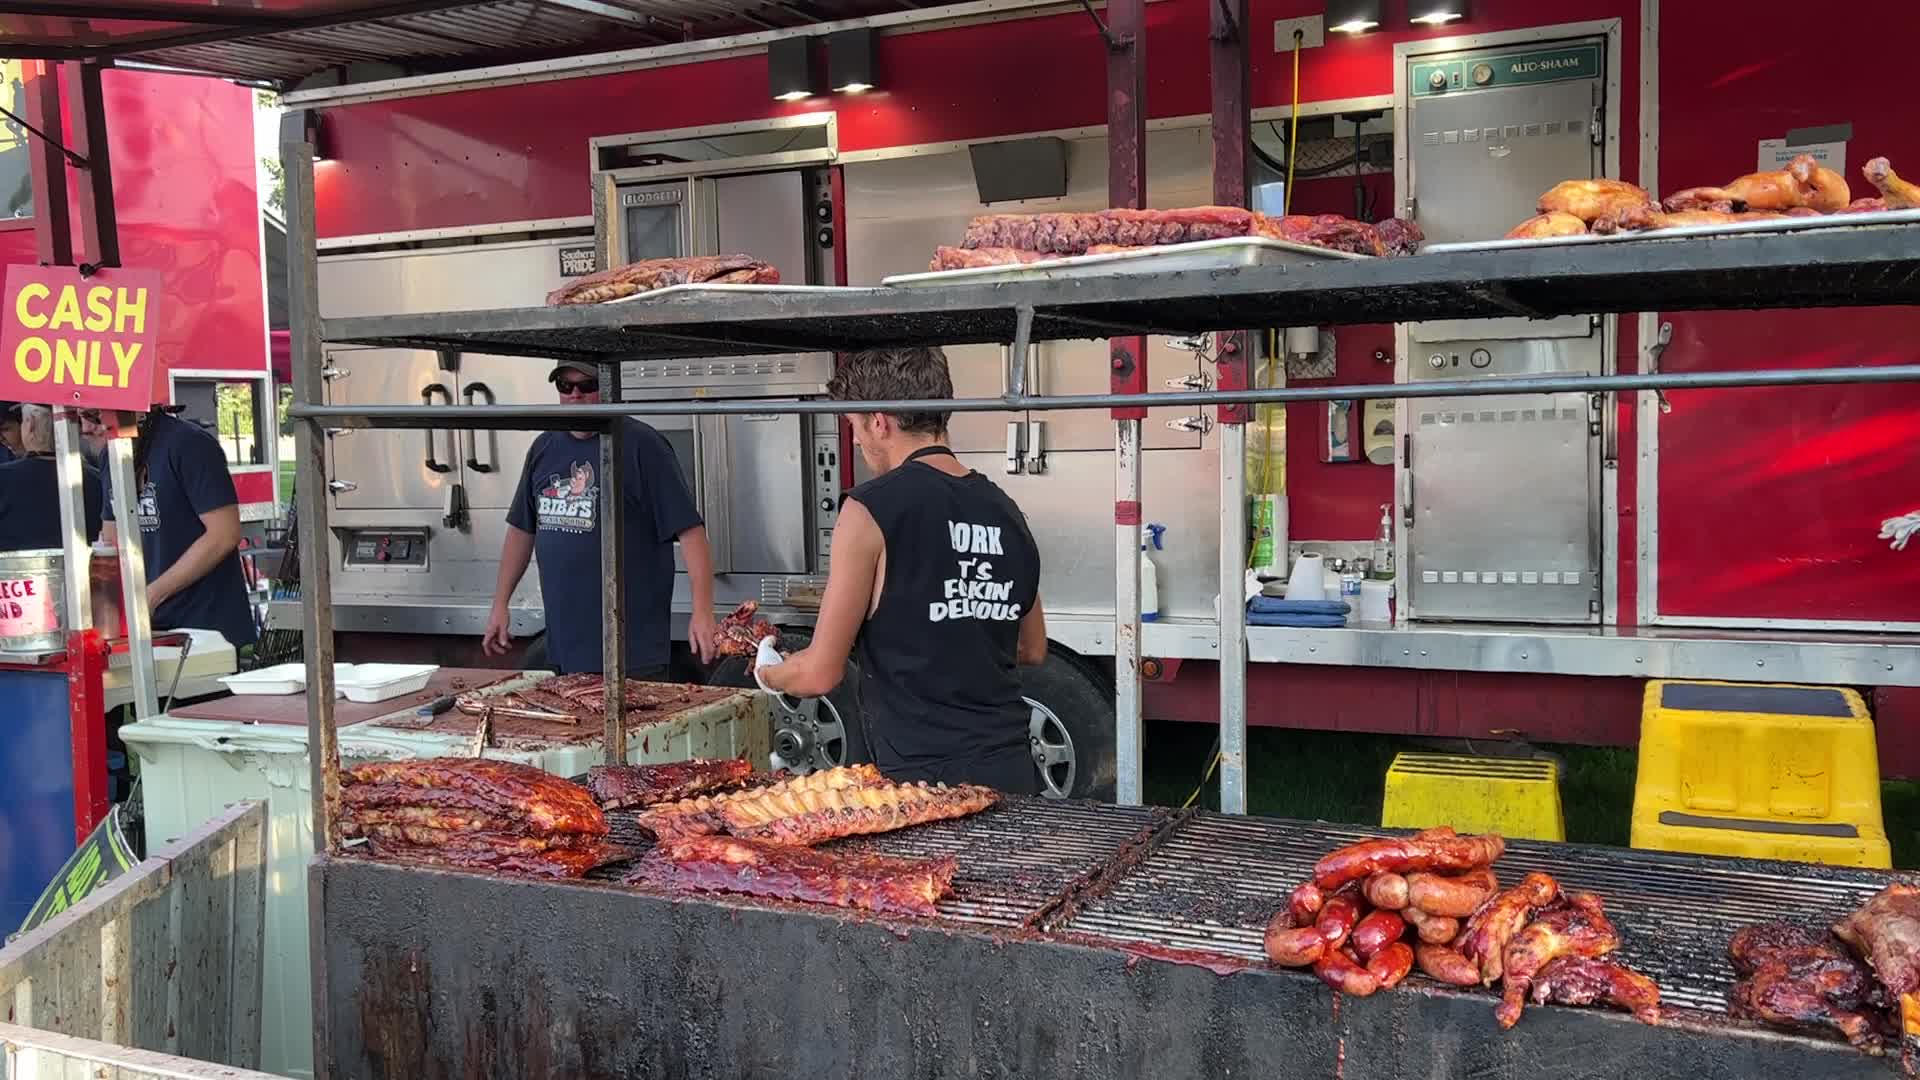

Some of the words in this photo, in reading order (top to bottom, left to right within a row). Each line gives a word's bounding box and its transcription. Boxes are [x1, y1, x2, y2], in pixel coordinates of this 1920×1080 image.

[1510, 57, 1579, 74] ALTO-SHAAM
[626, 190, 677, 204] BLODGETT
[560, 249, 595, 260] Southern
[562, 259, 595, 274] PRIDE
[15, 282, 148, 334] CASH
[14, 336, 143, 389] ONLY
[538, 497, 593, 518] BIBB'S
[957, 557, 993, 581] T'S
[0, 580, 36, 599] EGE
[0, 601, 23, 619] ND
